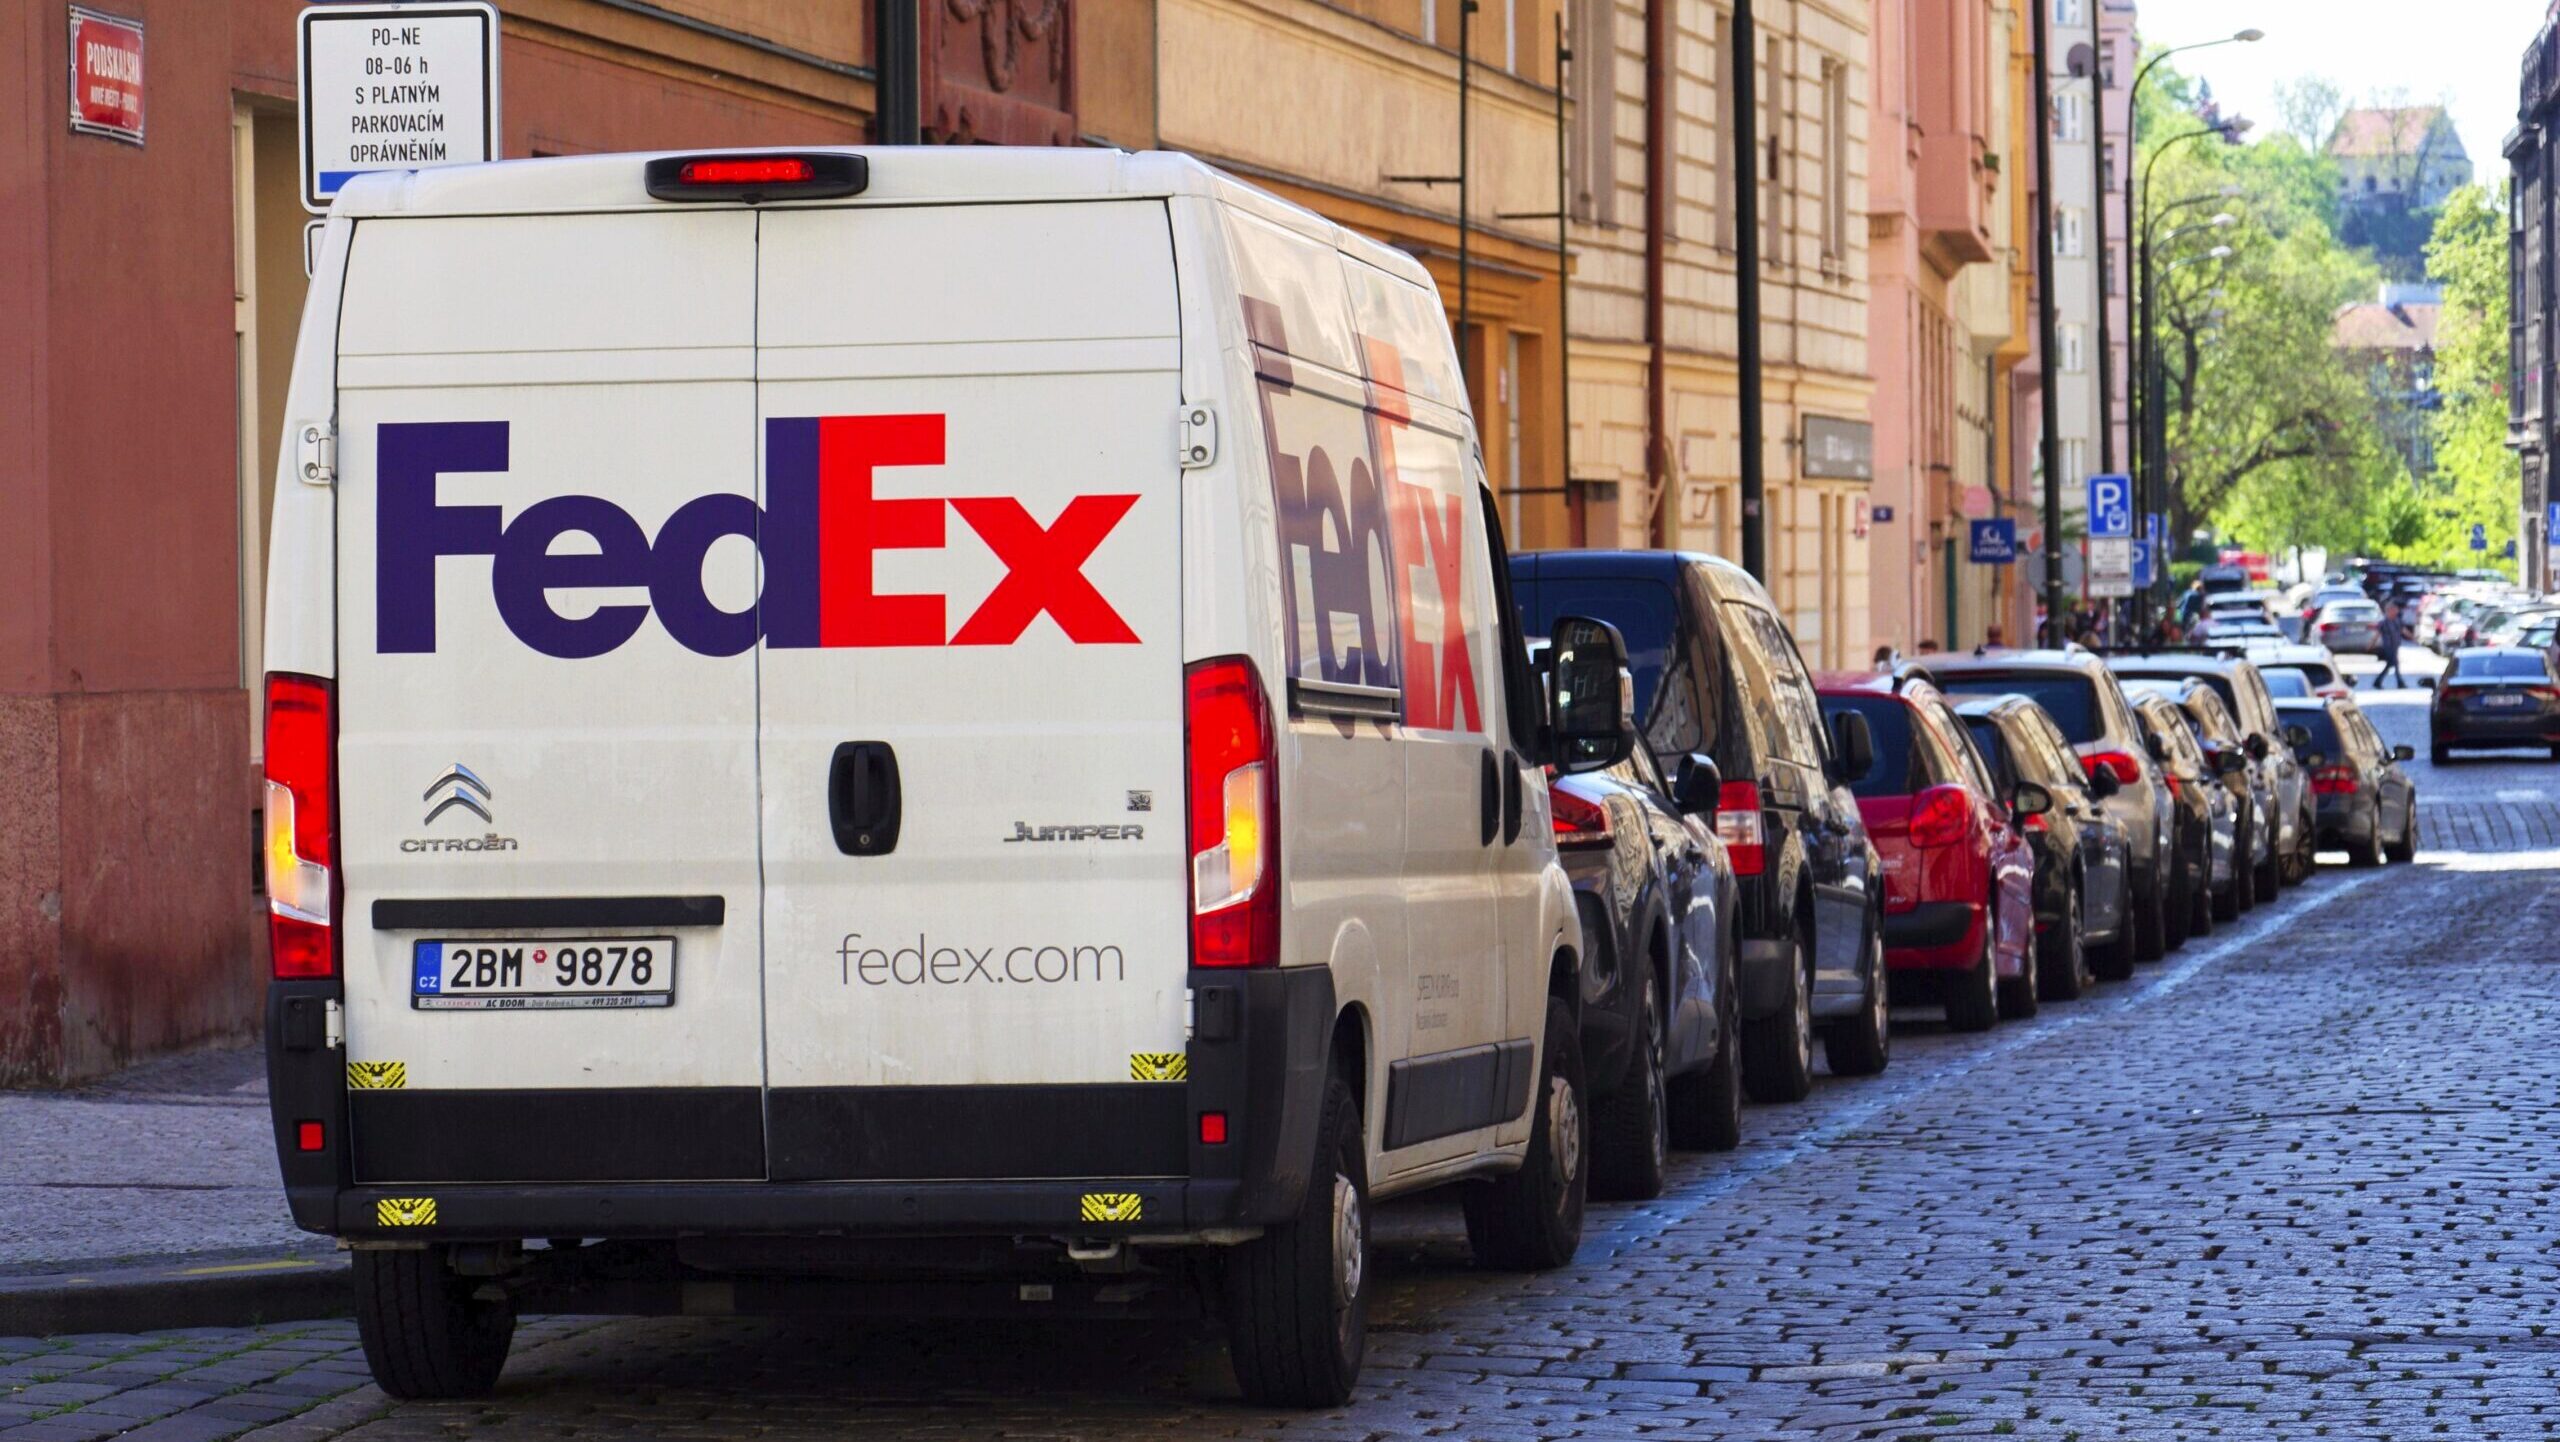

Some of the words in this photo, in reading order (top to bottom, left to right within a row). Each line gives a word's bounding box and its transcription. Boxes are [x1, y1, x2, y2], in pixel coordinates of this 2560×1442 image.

[372, 27, 421, 46] PO-NE
[366, 57, 412, 75] 08-06
[420, 56, 428, 74] h
[355, 87, 365, 104] S
[373, 80, 440, 104] PLATNÝM
[352, 109, 444, 133] PARKOVACÍM
[350, 138, 446, 162] OPRÁVNĚNÍM
[2096, 482, 2121, 518] P
[376, 413, 1143, 659] FedEx
[399, 833, 518, 853] CITROËN
[1003, 821, 1144, 842] JUMPER
[450, 949, 523, 988] 2BM
[556, 947, 653, 986] 9878
[836, 933, 1124, 985] fedex.com
[419, 976, 437, 988] CZ
